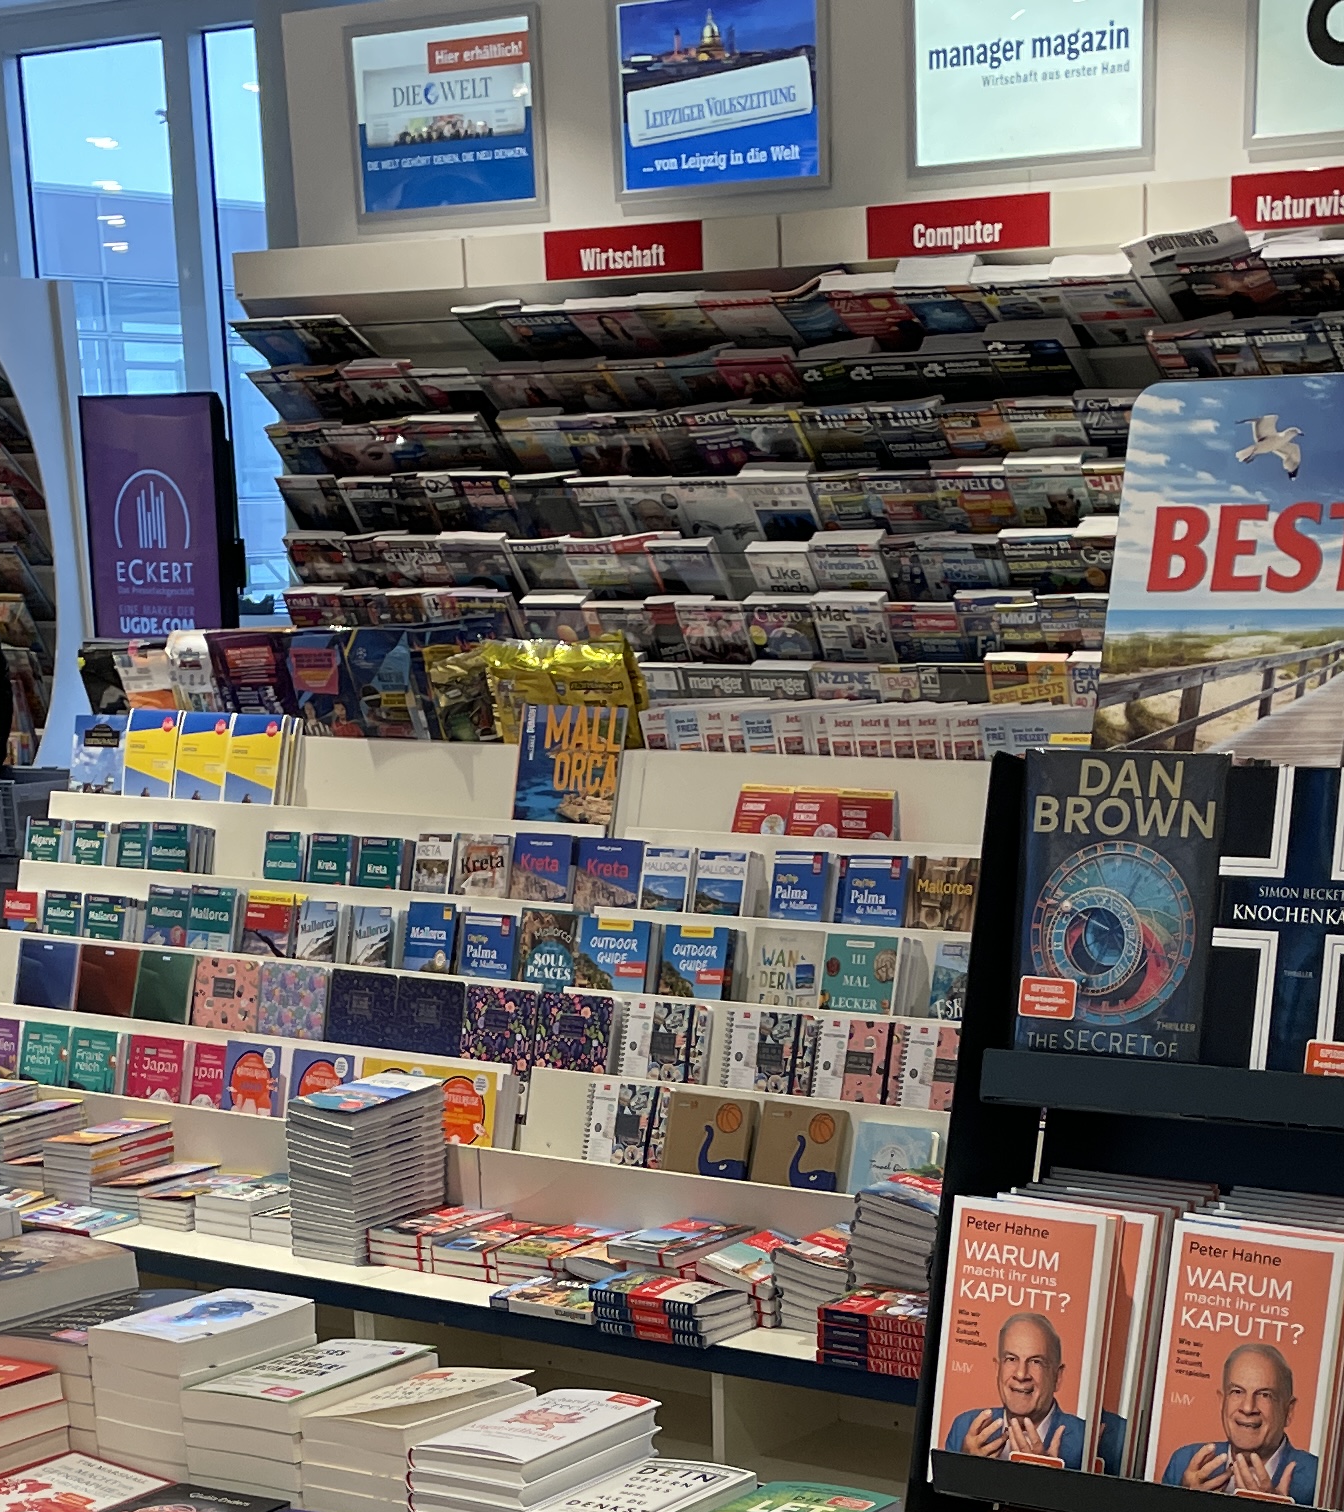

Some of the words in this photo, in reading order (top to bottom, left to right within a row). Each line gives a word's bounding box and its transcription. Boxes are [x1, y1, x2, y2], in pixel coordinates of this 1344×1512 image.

[435, 49, 459, 65] Hier
[463, 40, 523, 62] erhältlich!
[929, 38, 1024, 70] manager
[1032, 20, 1130, 61] magazin
[982, 72, 1038, 87] Wirtschaft
[1065, 65, 1097, 79] erster
[1101, 60, 1130, 74] Hand
[392, 83, 422, 108] DIE
[441, 76, 493, 101] WELT
[645, 104, 705, 129] LEIPZIGER
[705, 85, 797, 117] VOLKSZEITUNG
[681, 152, 726, 171] Leipzig
[730, 149, 744, 165] in
[747, 148, 767, 162] die
[771, 145, 800, 160] Welt
[913, 220, 1003, 250] Computer
[580, 243, 665, 271] Wirtschaft
[116, 559, 193, 585] ECKERT
[767, 565, 802, 582] Like
[816, 605, 851, 622] Mac
[688, 674, 744, 695] manager
[543, 705, 621, 753] MALL
[552, 748, 618, 792] ORCA
[1078, 759, 1184, 800] DAN
[1033, 794, 1216, 839] BROWN
[31, 834, 57, 848] Algarve
[461, 853, 504, 874] Kreta
[850, 889, 886, 905] Palma
[916, 879, 973, 896] Mallorca
[1258, 885, 1299, 900] SIMON
[191, 907, 228, 922] Mallorca
[590, 936, 638, 952] OUTDOOR
[533, 953, 566, 966] SOUL
[597, 952, 627, 965] GUIDE
[842, 975, 870, 988] MAL
[830, 996, 877, 1011] LECKER
[1027, 1031, 1059, 1050] THE
[1062, 1029, 1153, 1055] SECRET
[1155, 1041, 1178, 1058] OF
[142, 1057, 178, 1075] Japan
[966, 1215, 1002, 1232] Peter
[1004, 1221, 1051, 1240] Hahne
[963, 1239, 1060, 1272] WARUM
[1189, 1241, 1228, 1261] Peter
[1232, 1247, 1282, 1268] Hahne
[963, 1264, 1005, 1281] macht
[1008, 1268, 1027, 1284] ihr
[1030, 1273, 1057, 1287] uns
[1186, 1266, 1293, 1301] WARUM
[960, 1279, 1071, 1313] KAPUTT?
[1184, 1290, 1232, 1309] macht
[1236, 1295, 1256, 1311] ihr
[1260, 1301, 1290, 1317] uns
[1181, 1306, 1305, 1345] KAPUTT?
[638, 1467, 718, 1484] DEIN
